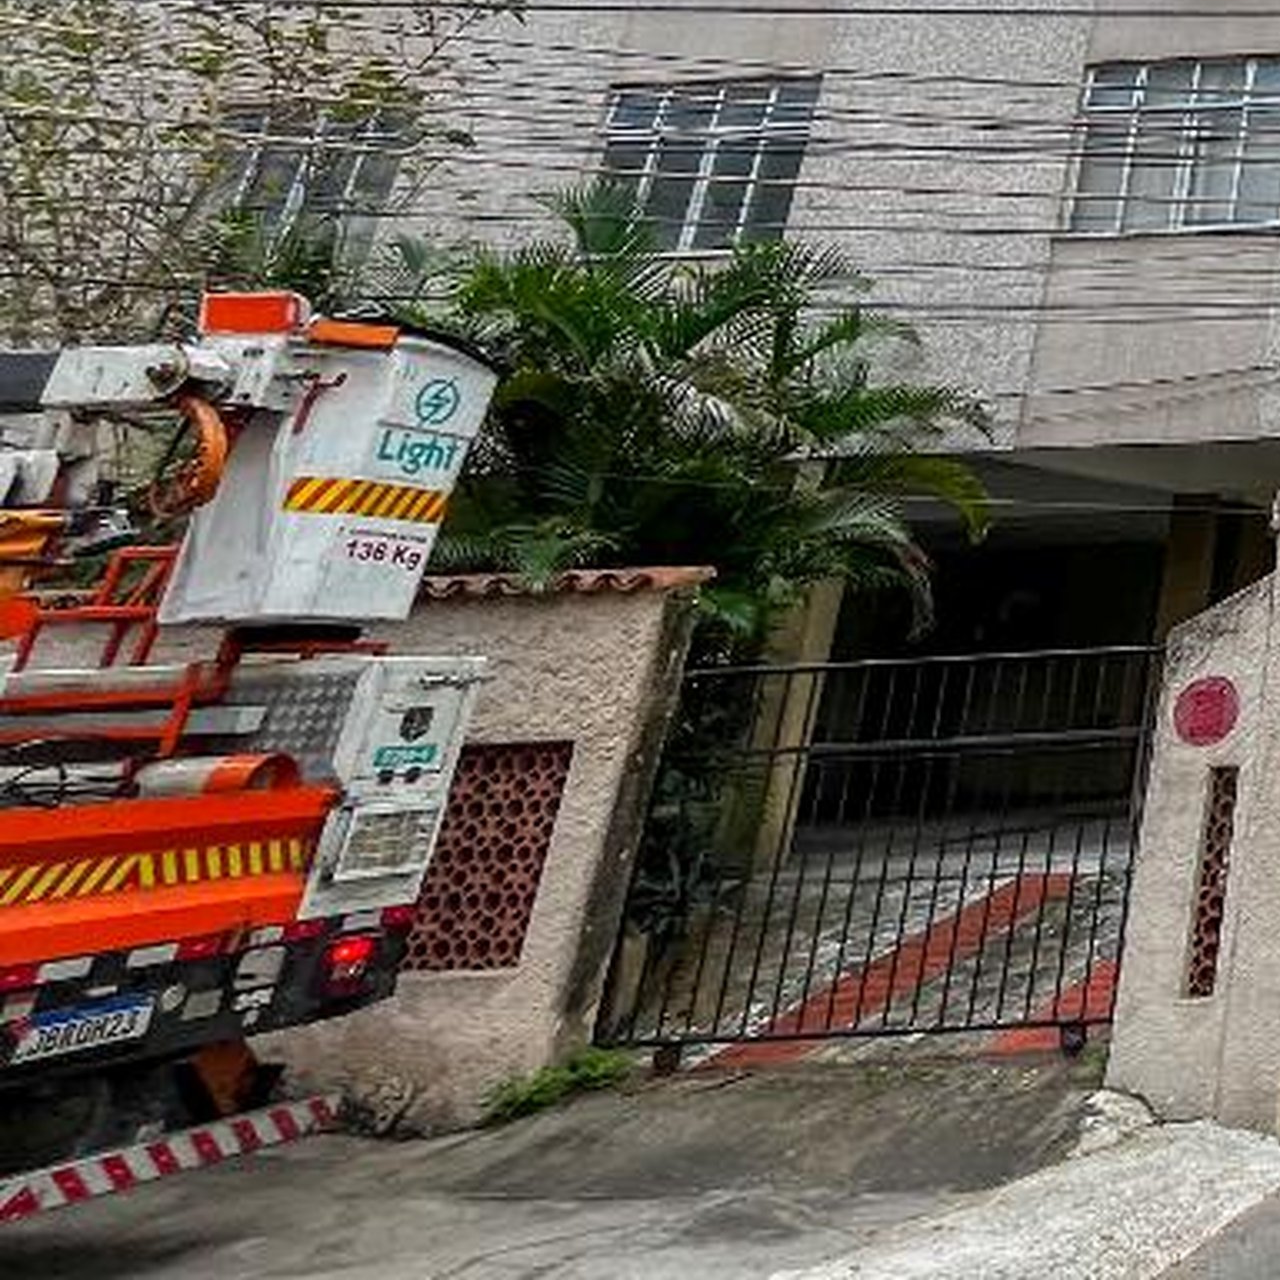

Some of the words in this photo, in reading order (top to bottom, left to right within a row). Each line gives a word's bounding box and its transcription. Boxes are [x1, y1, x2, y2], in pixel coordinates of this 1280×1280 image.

[375, 428, 460, 475] Light
[346, 539, 388, 562] 136
[391, 544, 422, 571] Kg
